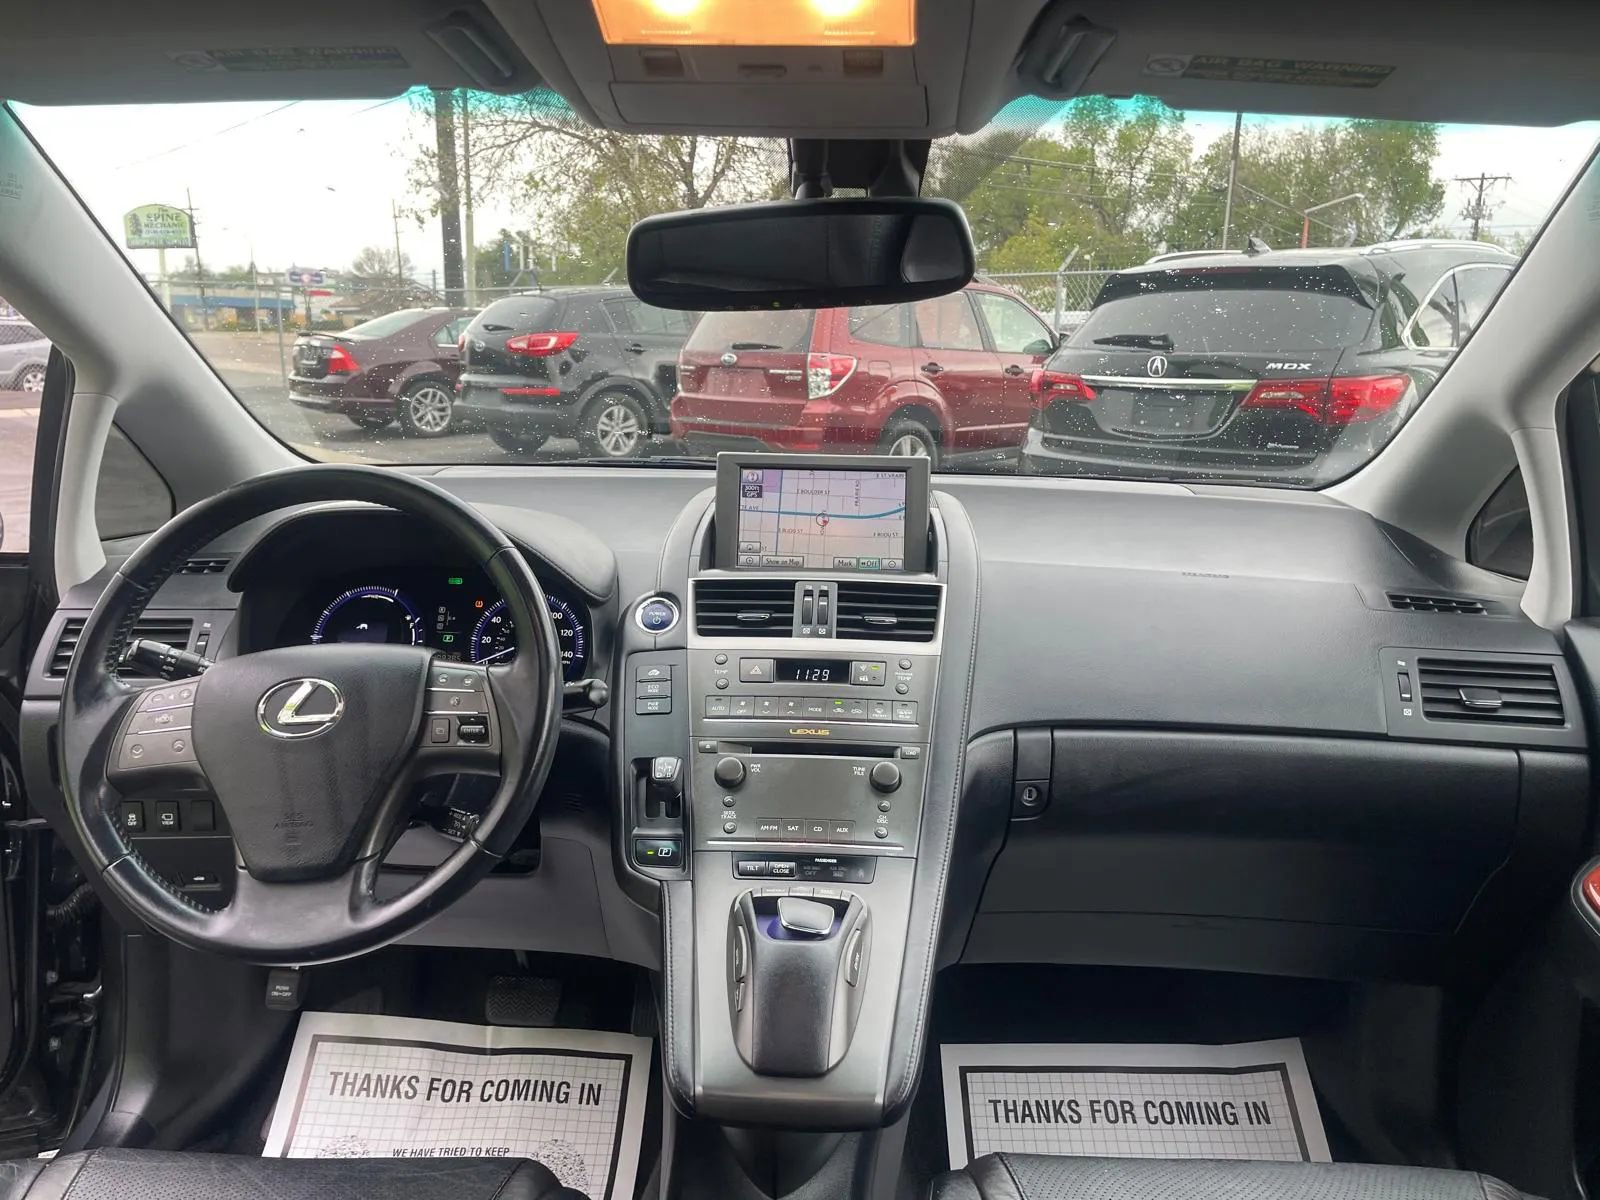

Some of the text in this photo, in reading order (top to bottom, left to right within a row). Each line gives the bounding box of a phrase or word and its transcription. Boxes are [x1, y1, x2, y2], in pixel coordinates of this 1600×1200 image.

[146, 212, 182, 221] SPINE
[1265, 362, 1312, 371] MDX
[837, 559, 853, 567] Mark
[491, 616, 502, 624] 40
[560, 629, 574, 637] 120
[481, 636, 492, 644] 20
[789, 728, 830, 736] LEXUS
[328, 1071, 602, 1107] THANKS FOR COMING IN
[988, 1099, 1273, 1126] THANKS FOR COMING IN
[392, 1147, 510, 1158] WE HAVE TRIED TO KEEP
